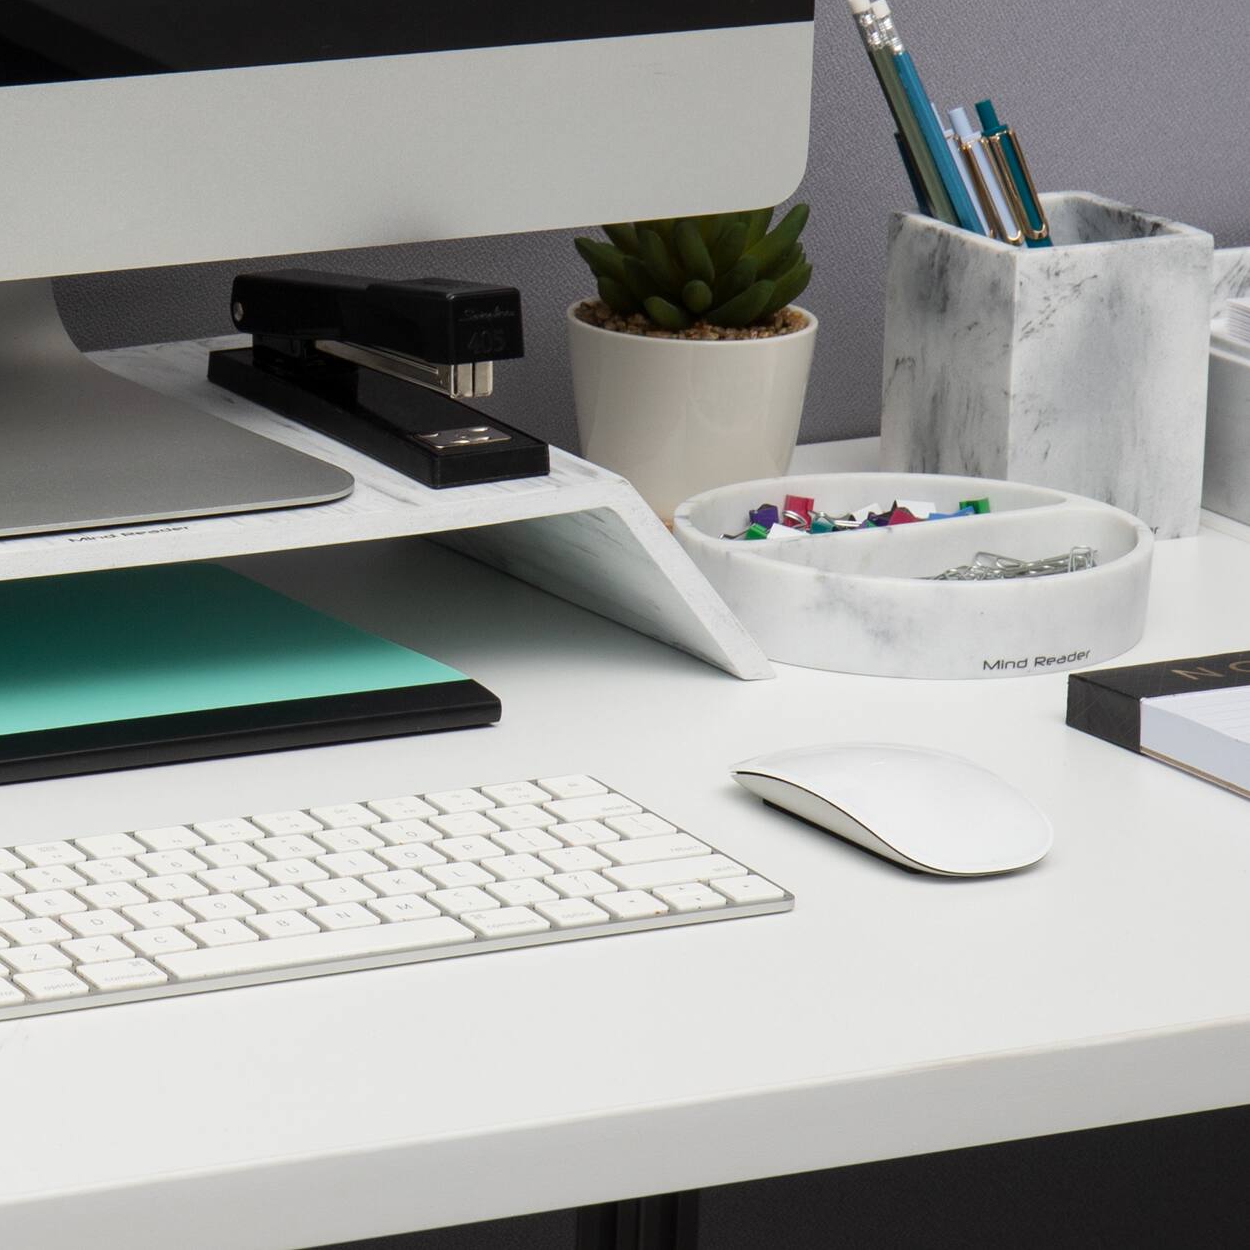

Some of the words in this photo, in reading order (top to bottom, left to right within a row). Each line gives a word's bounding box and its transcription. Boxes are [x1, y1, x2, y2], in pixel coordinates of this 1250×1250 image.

[467, 328, 506, 354] 405
[67, 532, 116, 543] Mind
[121, 525, 190, 538] Reader
[982, 658, 1028, 671] Mind
[1034, 649, 1091, 667] Reader
